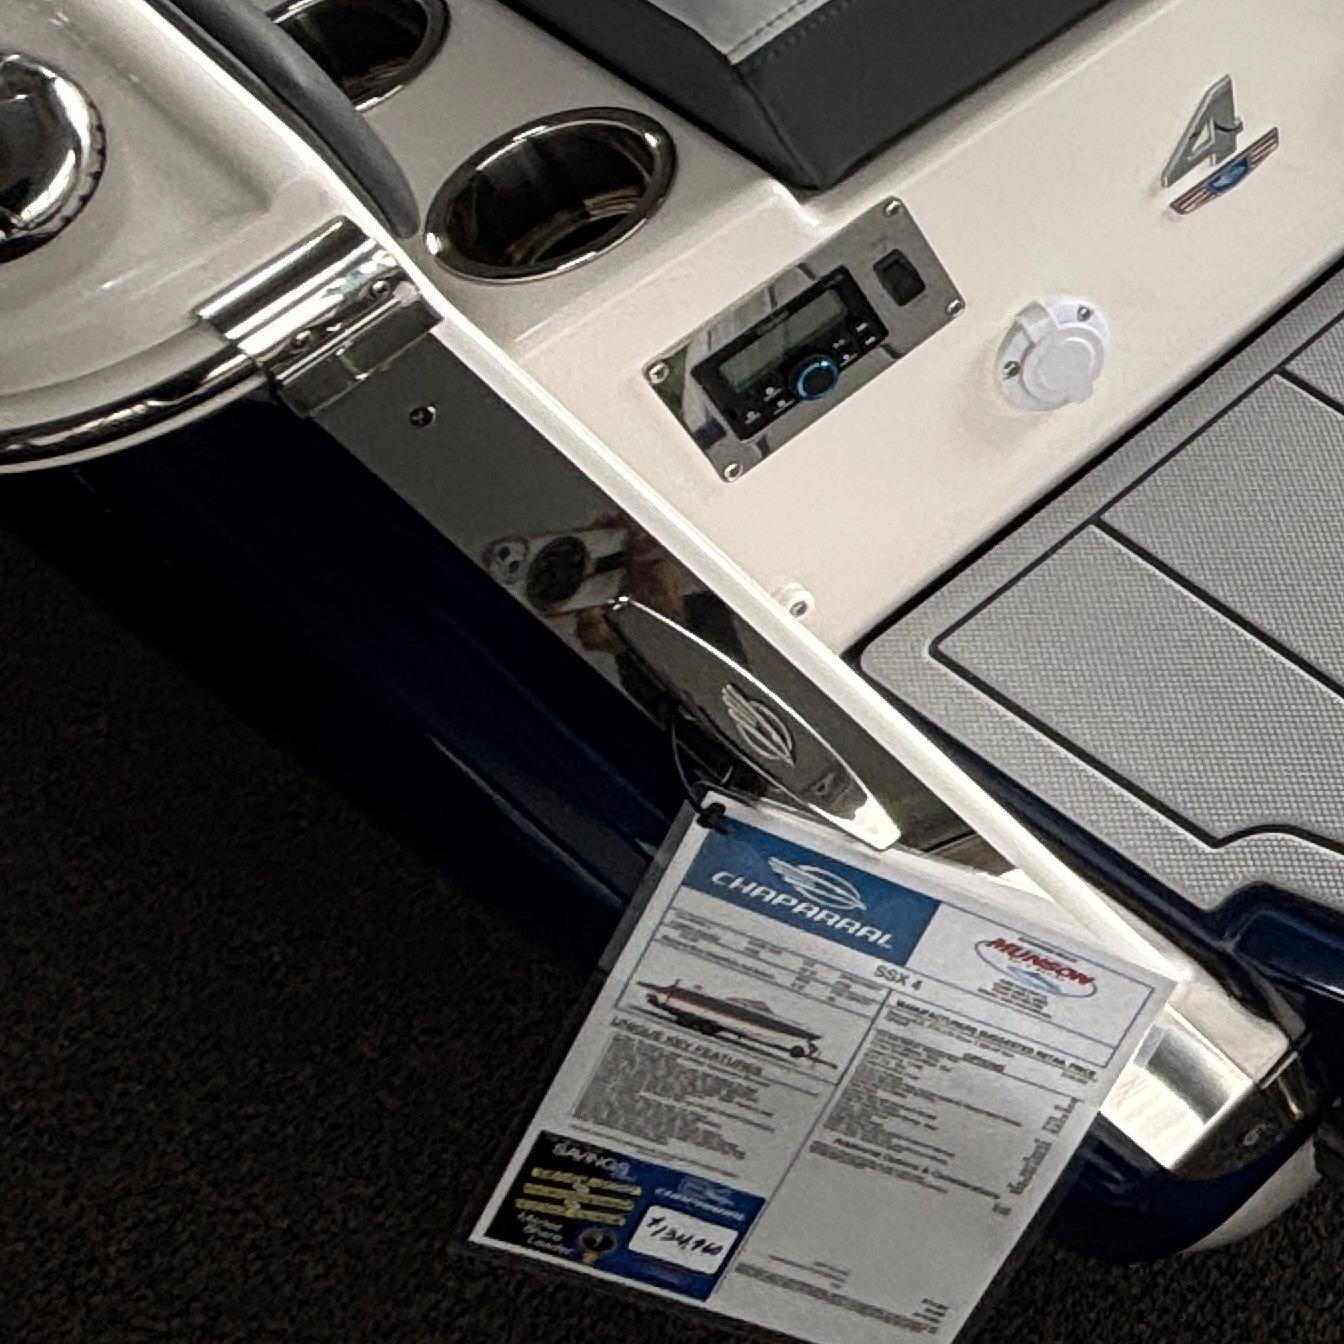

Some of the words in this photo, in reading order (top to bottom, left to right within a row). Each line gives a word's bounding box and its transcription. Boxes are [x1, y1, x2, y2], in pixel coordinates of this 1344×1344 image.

[711, 869, 894, 949] CHAPARRAL
[874, 963, 909, 987] SSX
[909, 979, 923, 992] 4
[986, 936, 1096, 987] MUNSON
